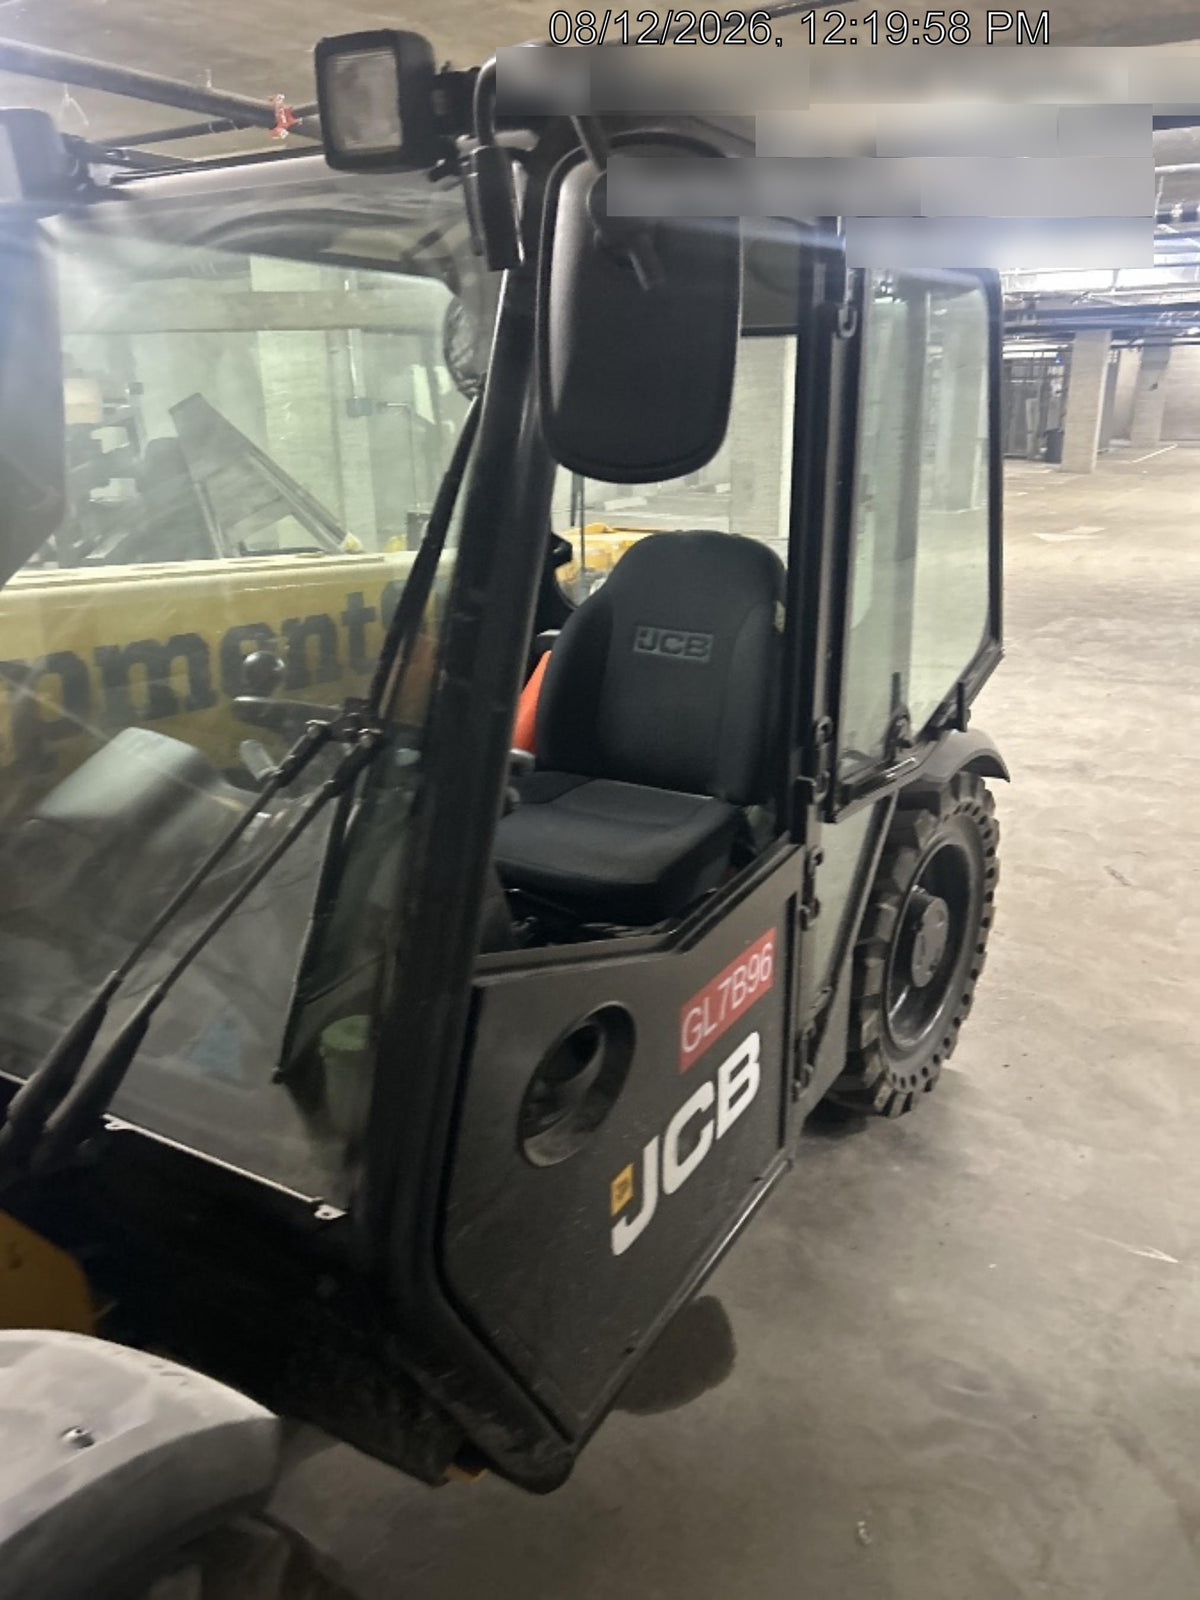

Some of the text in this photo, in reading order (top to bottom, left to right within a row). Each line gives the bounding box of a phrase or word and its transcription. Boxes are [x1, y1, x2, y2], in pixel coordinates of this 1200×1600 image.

[635, 626, 712, 659] JCB
[681, 941, 774, 1053] GL7B96
[611, 1031, 760, 1256] JCB
